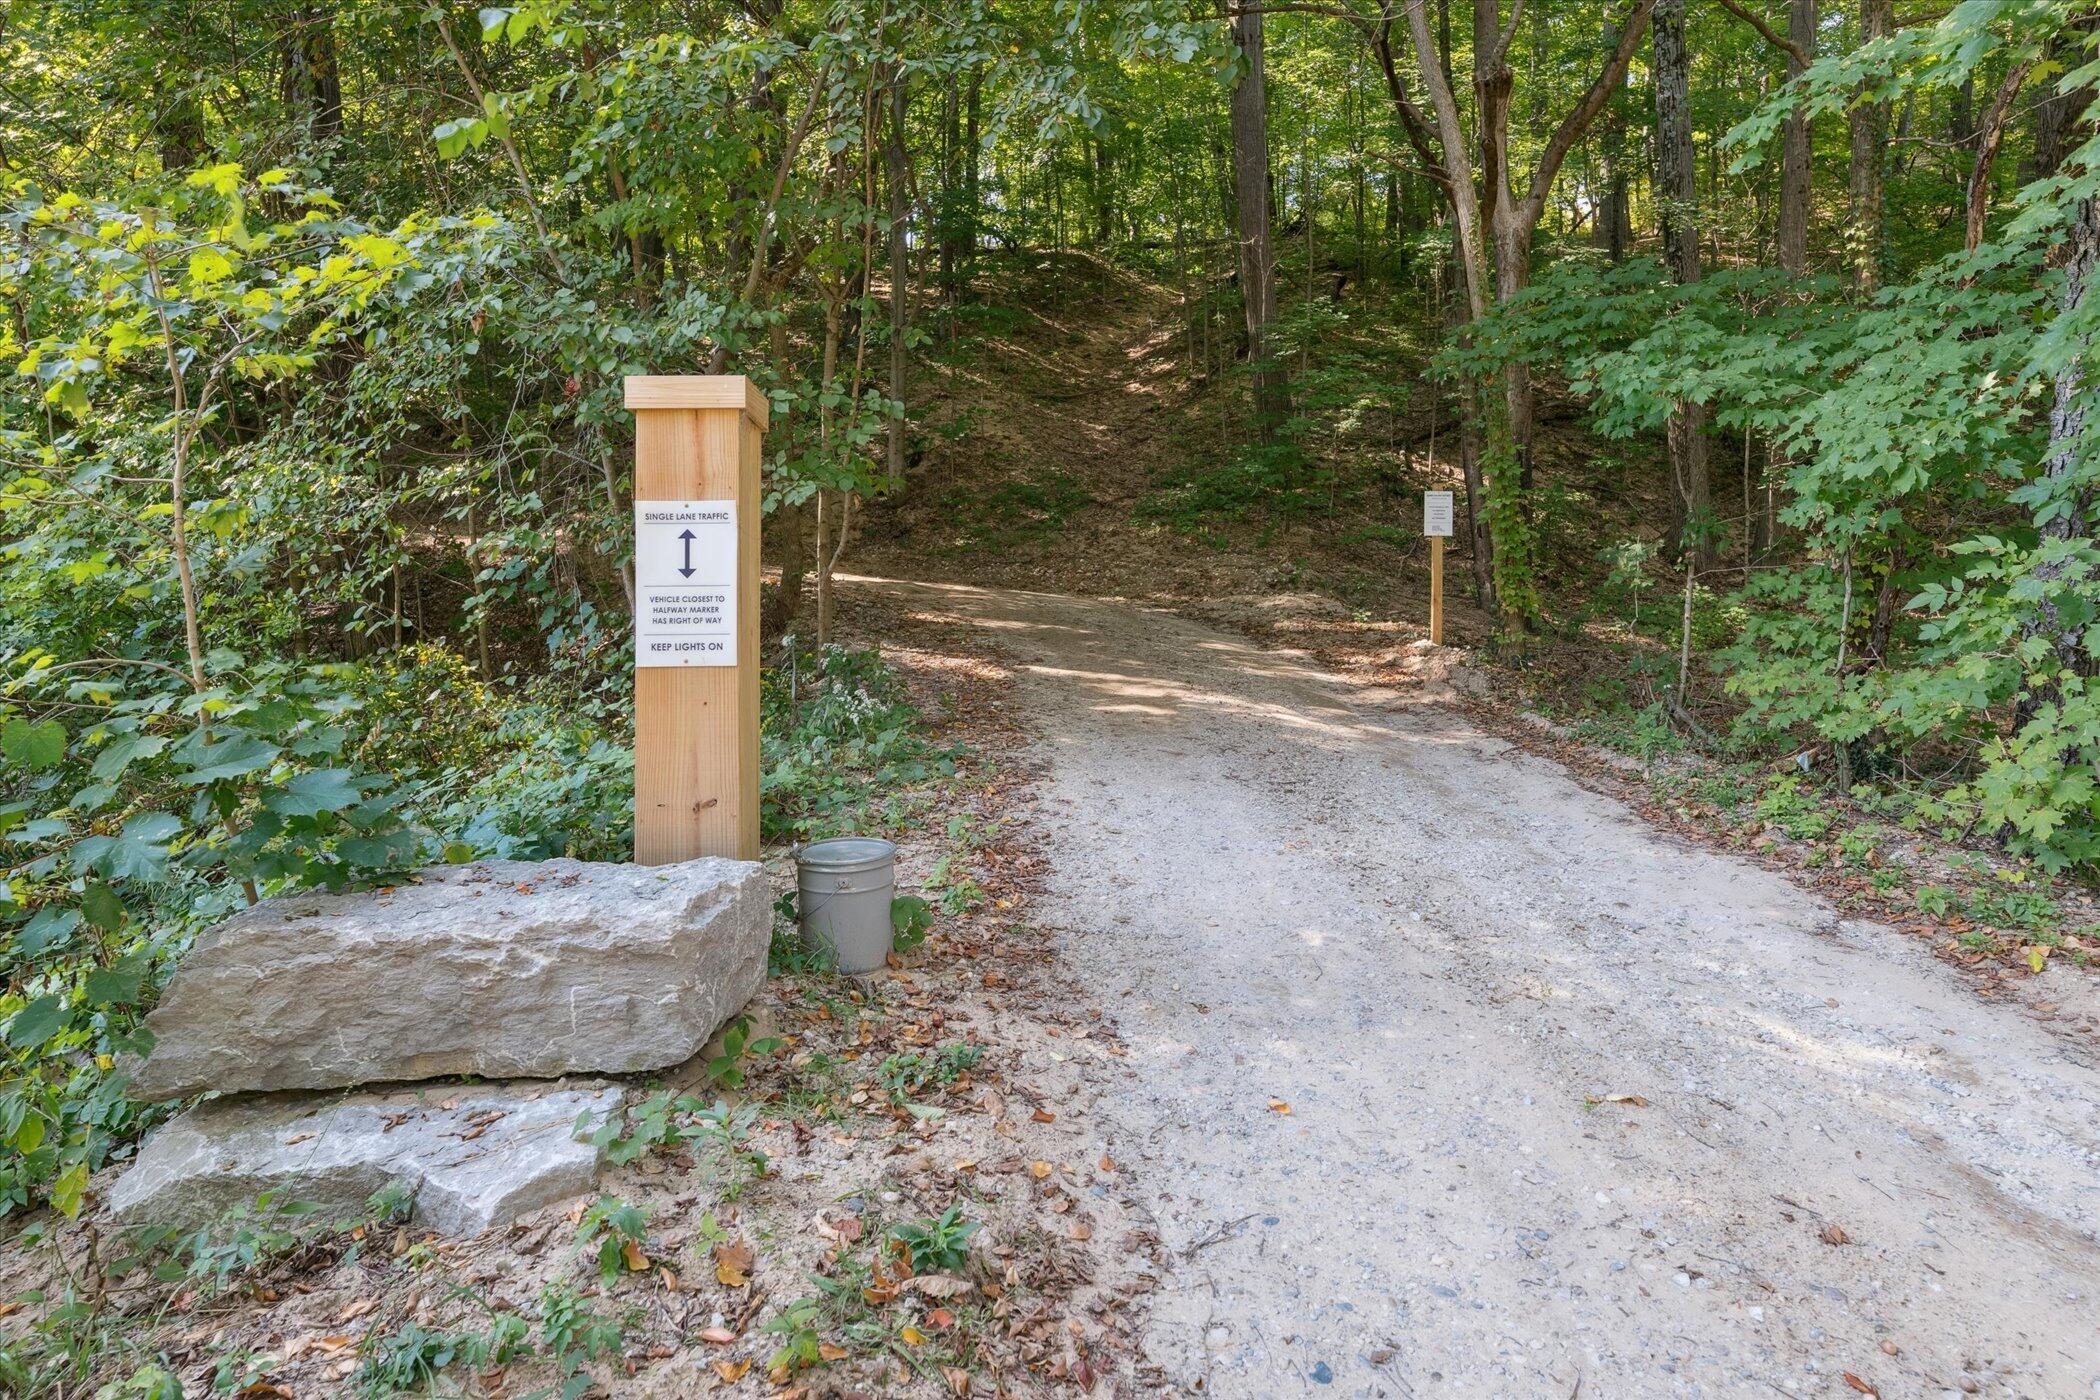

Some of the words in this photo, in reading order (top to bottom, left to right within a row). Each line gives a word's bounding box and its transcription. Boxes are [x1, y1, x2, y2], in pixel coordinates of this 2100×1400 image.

[645, 512, 674, 521] SINGLE
[676, 512, 696, 520] LANE
[651, 643, 672, 652] KEEP
[675, 643, 706, 651] LIGHTS
[708, 643, 723, 651] ON
